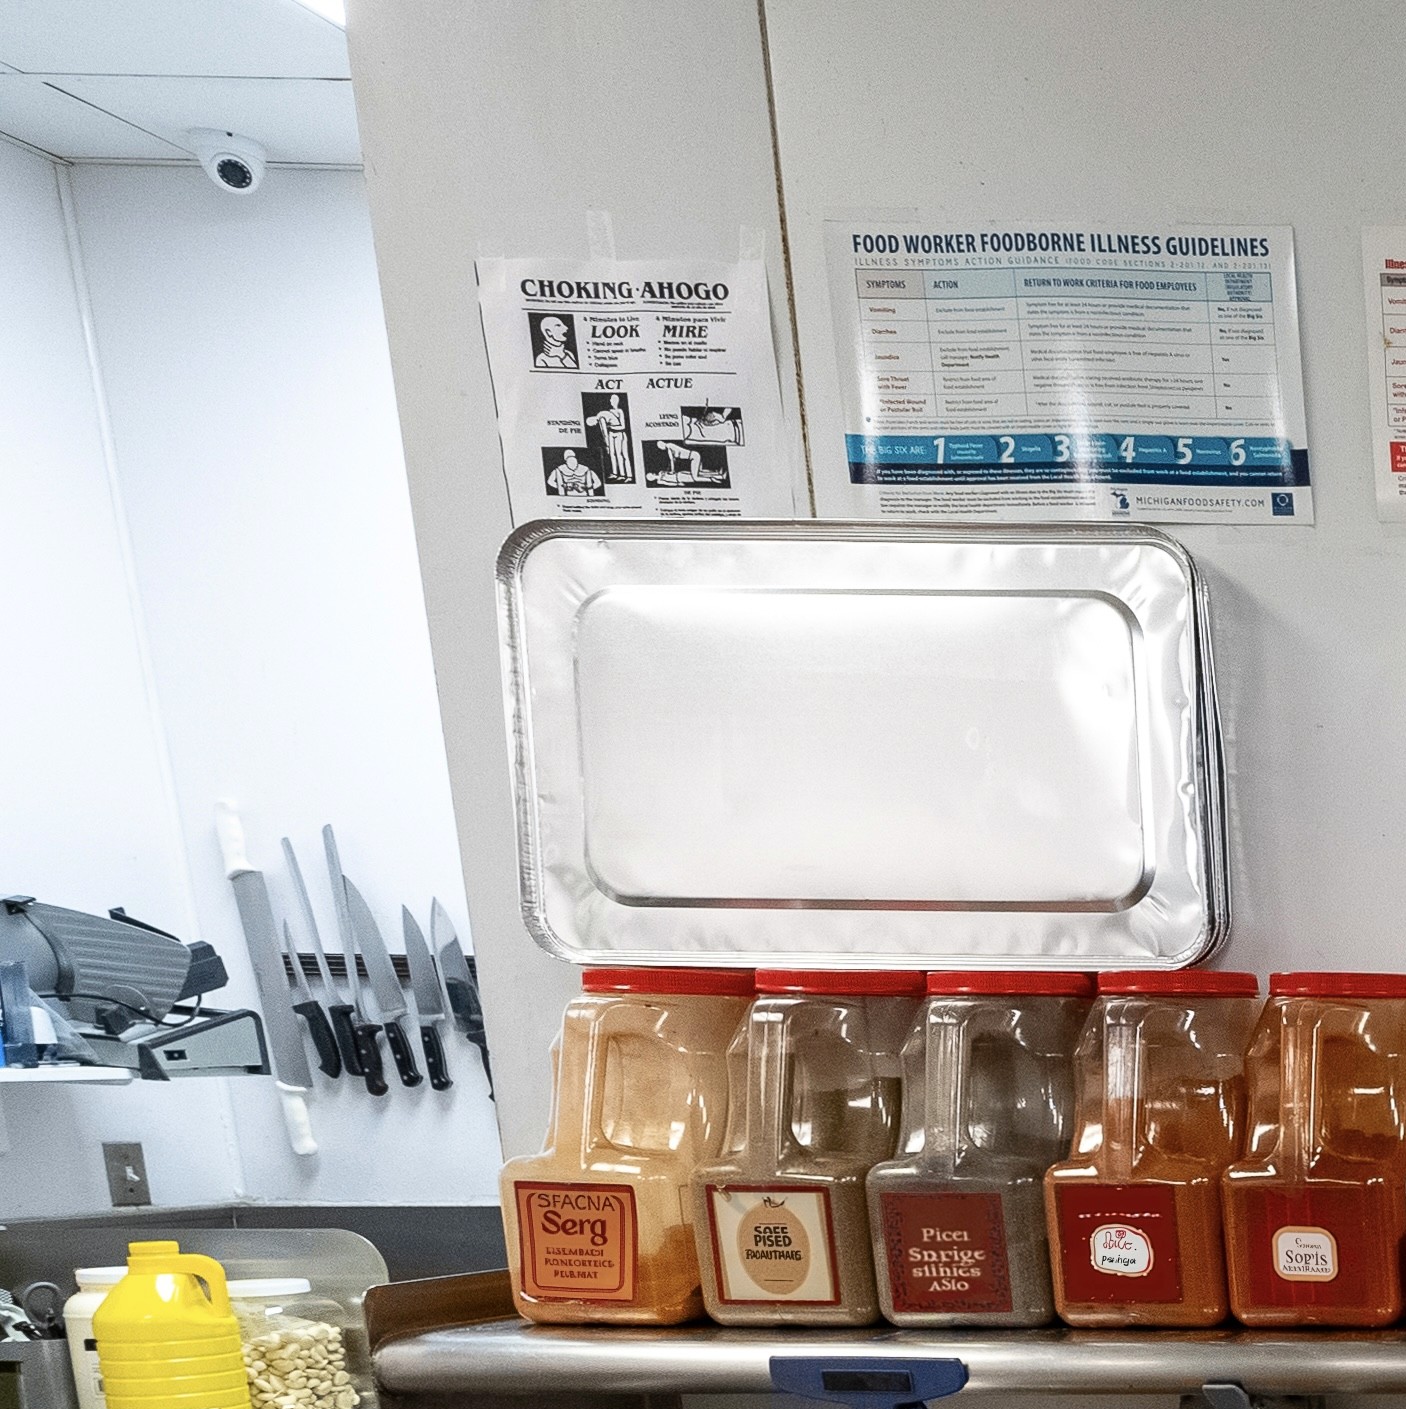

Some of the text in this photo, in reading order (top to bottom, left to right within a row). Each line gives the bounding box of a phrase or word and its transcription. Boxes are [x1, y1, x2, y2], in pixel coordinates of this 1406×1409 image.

[852, 232, 1270, 258] FOOD WORKER FOODBORNE ILLNESS GUIDELINES
[854, 256, 1060, 267] ILLNESS SYMPTOMS ACTION GUIDANCE
[520, 278, 730, 301] CHOKING AHOGO
[867, 280, 906, 290] SYMPTOMS
[933, 280, 959, 290] ACTION
[1024, 278, 1197, 292] RETURN TO WORK CRITERIA FOR FOOD EMPLOYEES
[591, 324, 641, 339] LOOK
[662, 324, 709, 339] MIRE
[594, 379, 624, 390] ACT
[646, 377, 693, 389] ACTUE
[879, 445, 908, 455] BIG SIX
[933, 437, 945, 464] 1
[1000, 436, 1015, 463] 2
[1054, 435, 1070, 462] 3
[1120, 436, 1136, 463] 4
[1176, 438, 1193, 465] 5
[1230, 438, 1246, 466] 6
[1136, 496, 1265, 508] MICHIGANFOODSAFETY.COM
[541, 1210, 608, 1246] Serg
